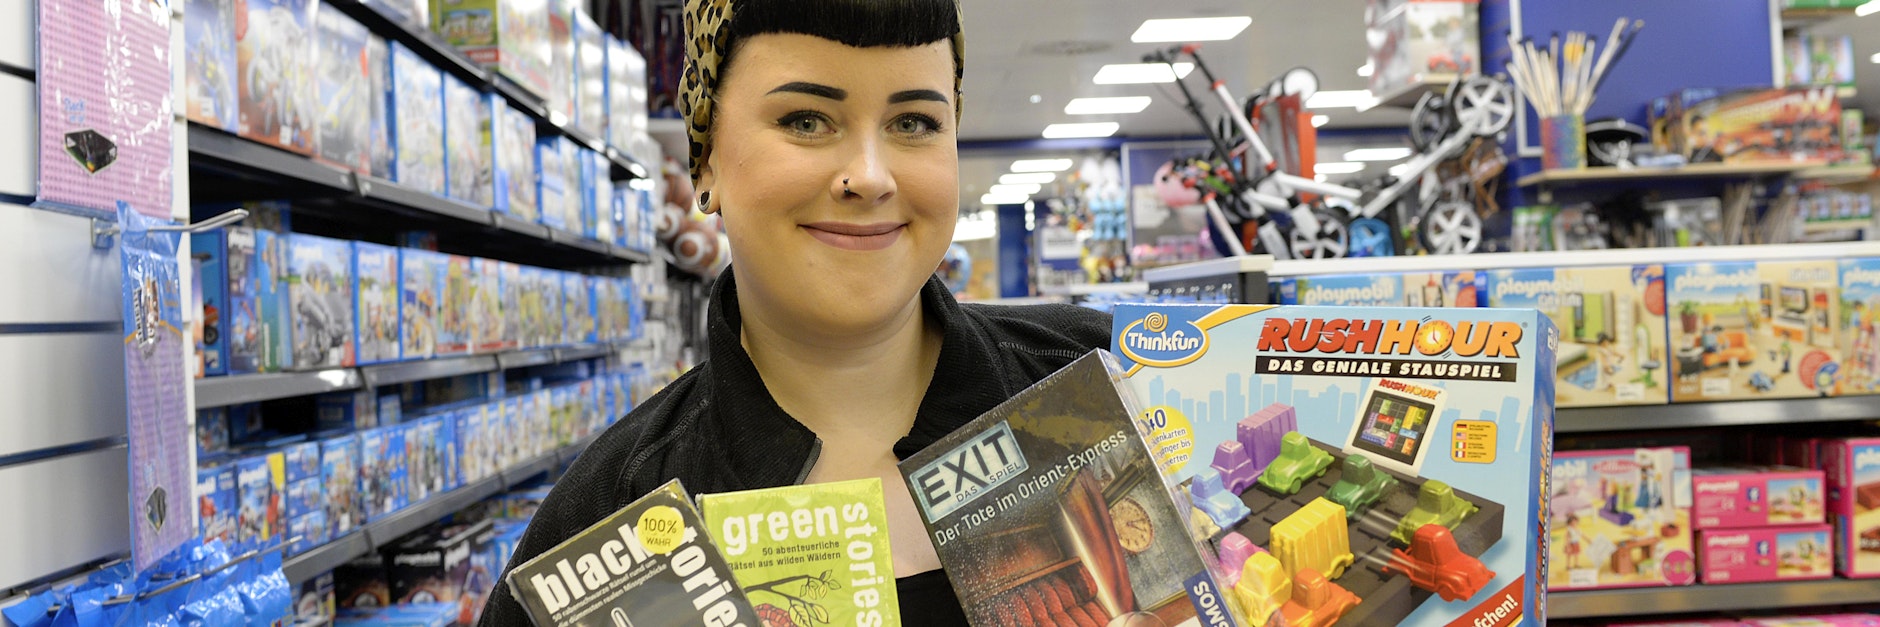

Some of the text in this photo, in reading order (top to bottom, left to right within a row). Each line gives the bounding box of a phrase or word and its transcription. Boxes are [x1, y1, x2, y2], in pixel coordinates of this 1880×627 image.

[1305, 282, 1395, 305] playmobil
[1268, 358, 1502, 378] DAS GENIALE STAUSPIEL
[1180, 439, 1191, 448] bis
[917, 429, 1008, 508] EXIT
[934, 429, 1128, 546] Der Tote im Orient-Express
[956, 461, 1022, 503] DAS SPIEL
[643, 518, 677, 534] 100%
[722, 505, 839, 556] green
[646, 536, 671, 547] WAHR
[762, 540, 840, 556] 50 abenteuerliche
[758, 559, 774, 568] aus
[777, 554, 805, 566] wilden
[807, 551, 841, 562] Wäldern
[842, 502, 885, 627] stories
